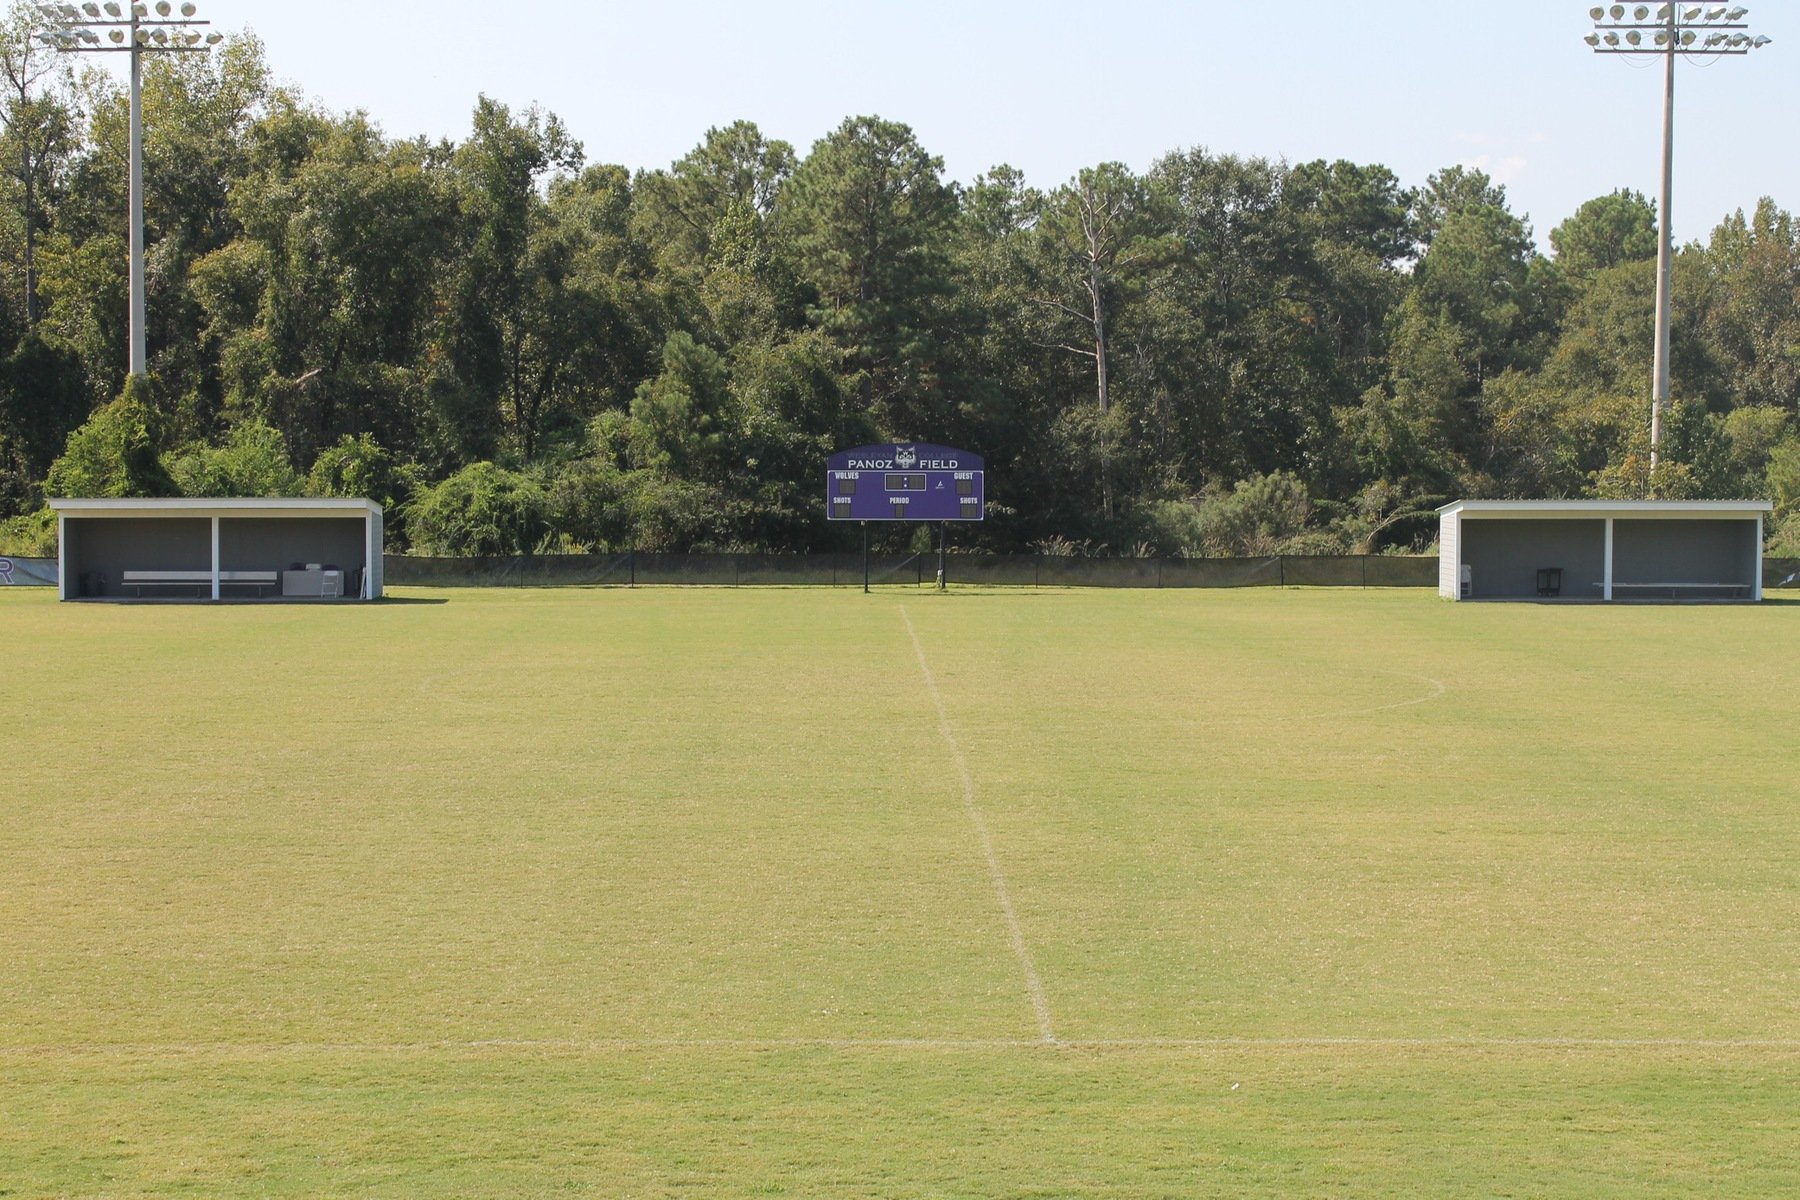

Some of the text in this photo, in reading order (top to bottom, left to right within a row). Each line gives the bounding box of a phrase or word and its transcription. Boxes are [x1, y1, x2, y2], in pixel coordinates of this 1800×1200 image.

[848, 459, 958, 469] PANOZ FIELD
[835, 472, 859, 480] WOLVES
[954, 472, 974, 480] GUEST
